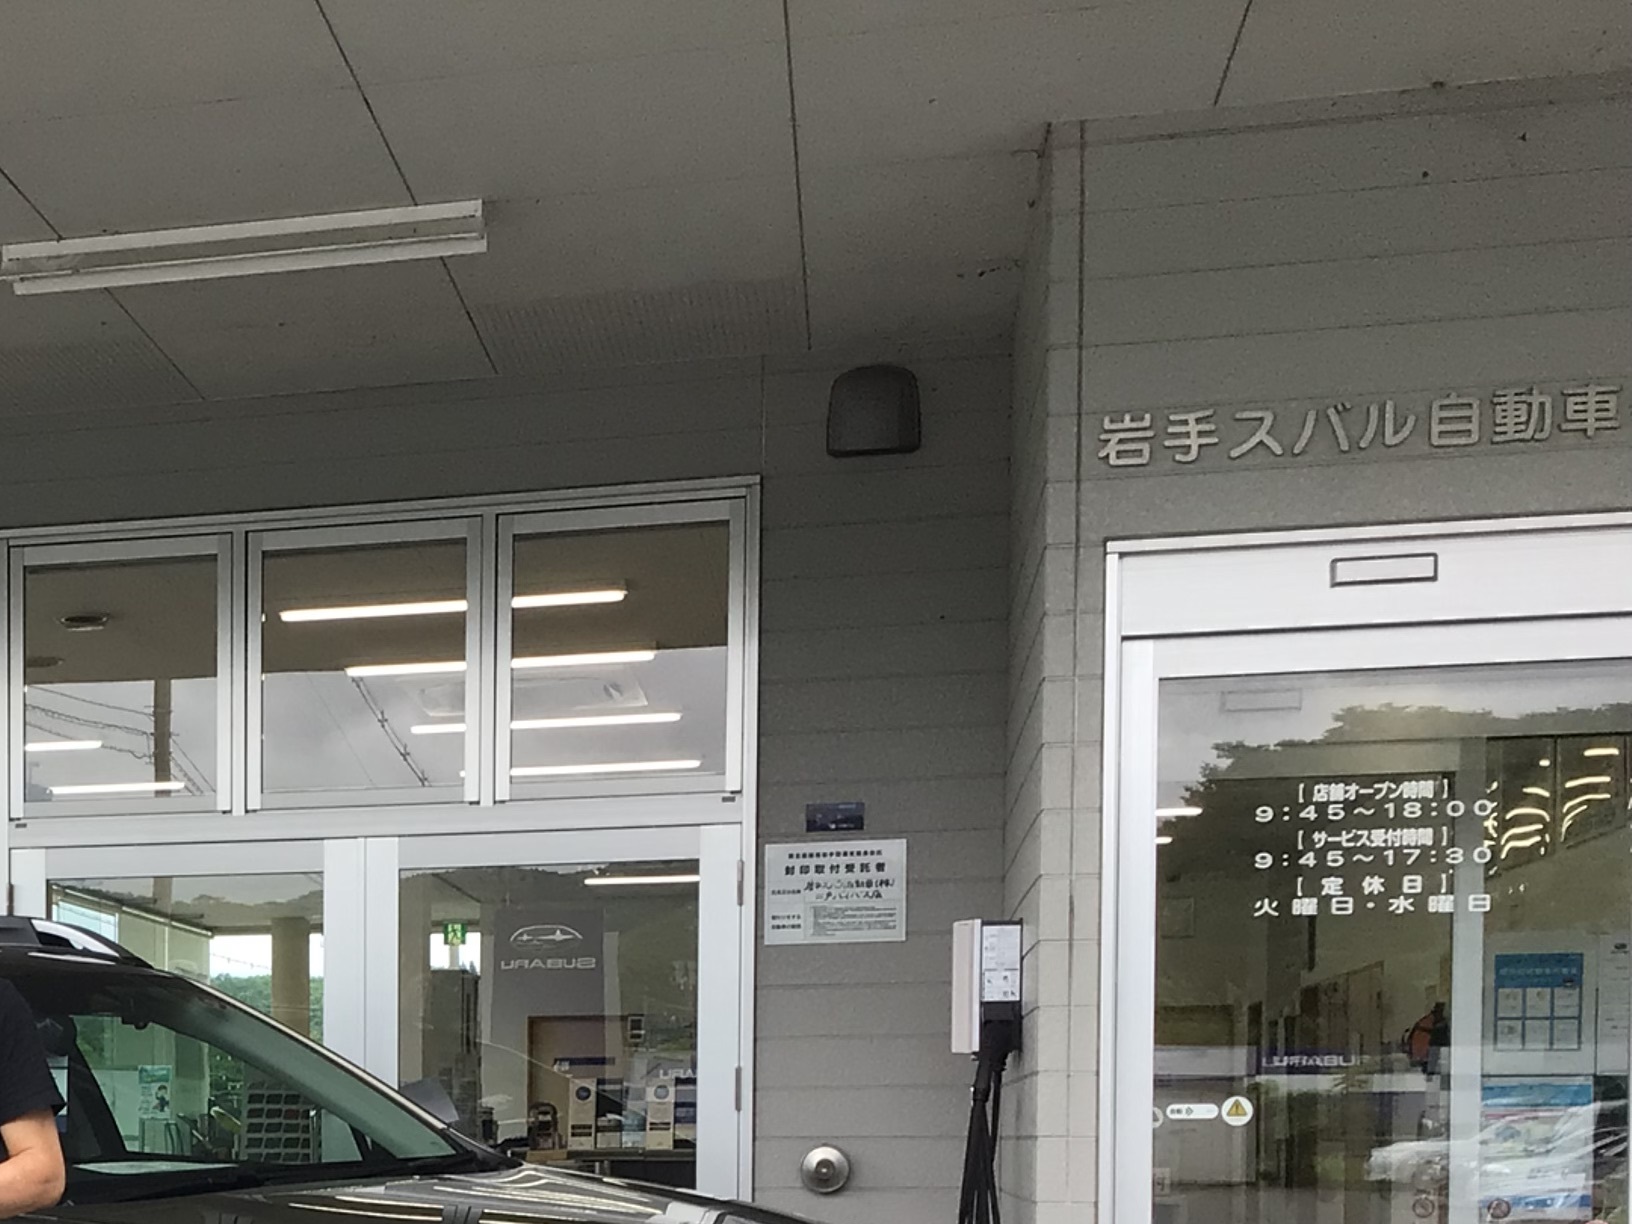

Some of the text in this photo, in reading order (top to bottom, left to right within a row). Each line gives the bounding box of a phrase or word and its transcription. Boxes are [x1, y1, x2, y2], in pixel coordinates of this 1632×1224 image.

[1097, 384, 1622, 467] 岩手スバル自動車
[1254, 893, 1491, 917] 火曜日・水曜日
